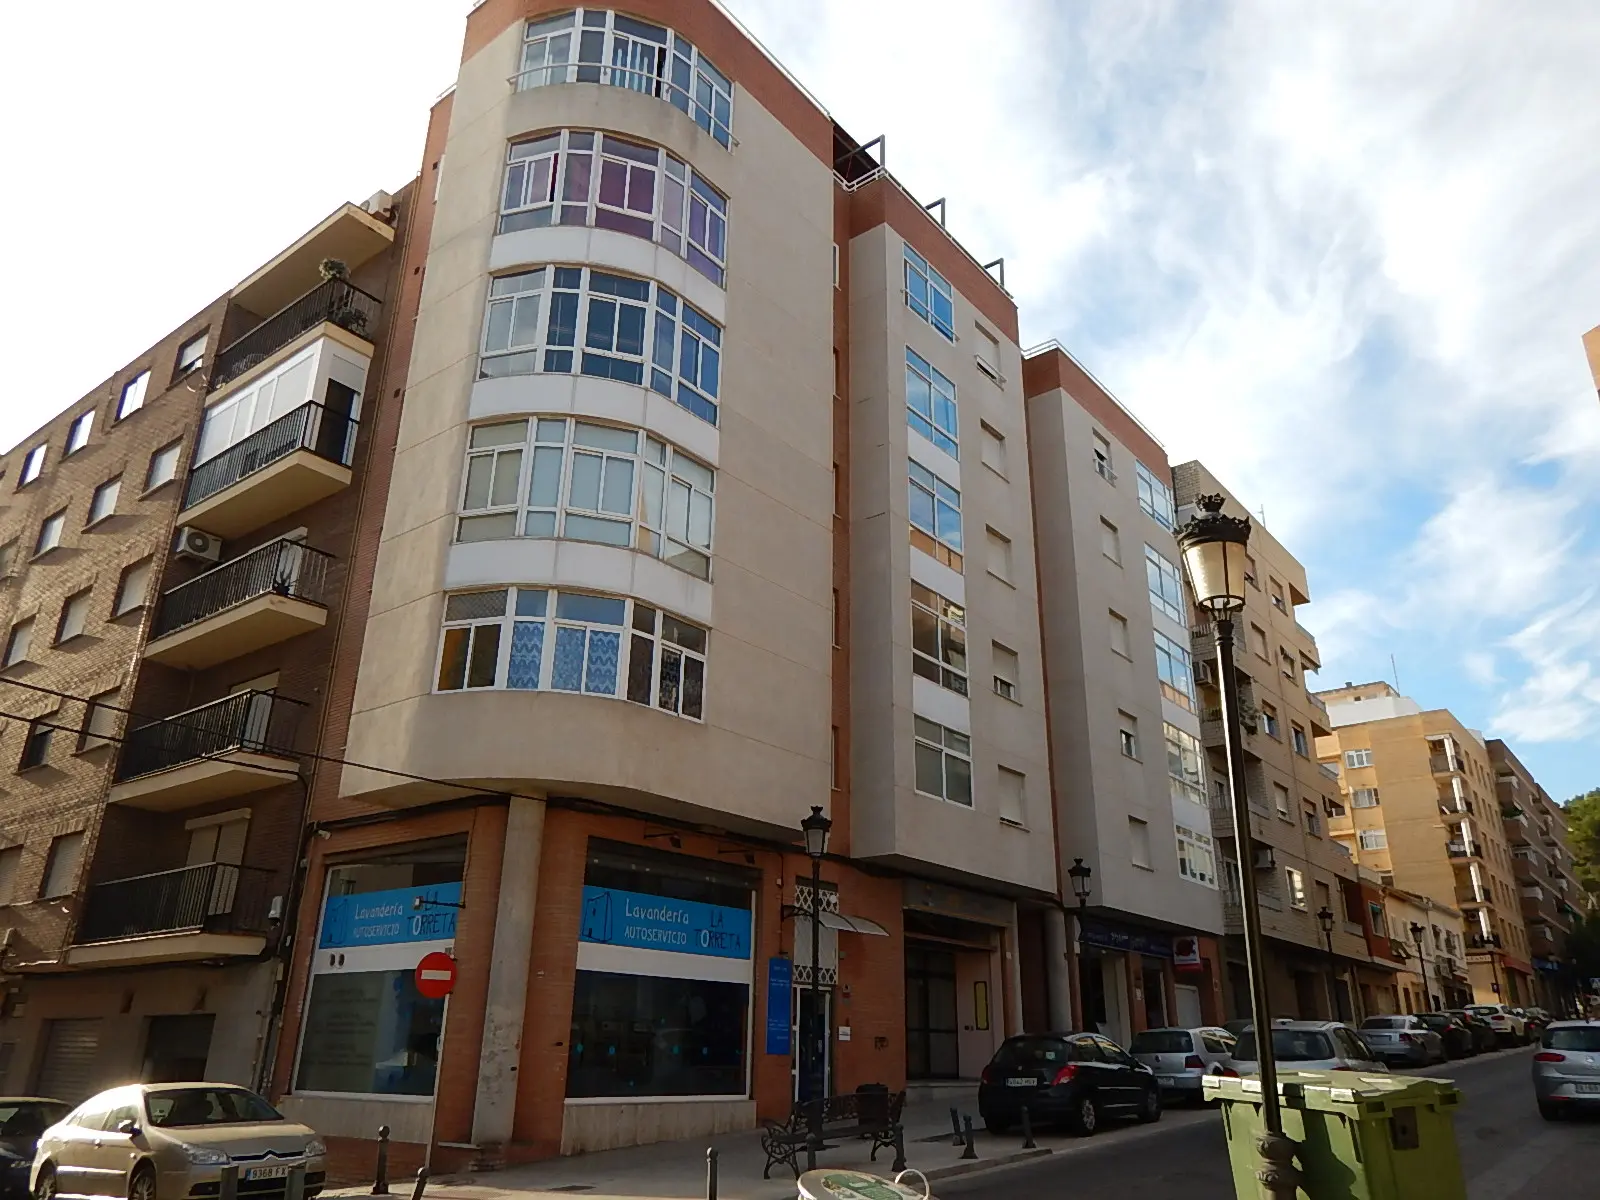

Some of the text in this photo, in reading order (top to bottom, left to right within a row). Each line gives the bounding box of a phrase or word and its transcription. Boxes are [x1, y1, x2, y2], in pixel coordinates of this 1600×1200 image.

[355, 902, 404, 920] Lavandería
[624, 897, 689, 925] Lavandería
[710, 909, 724, 928] LA
[407, 912, 456, 937] TORRETA
[624, 925, 687, 945] AUTOSERVICIO
[694, 929, 741, 951] TORRETA
[252, 1168, 273, 1179] 9368
